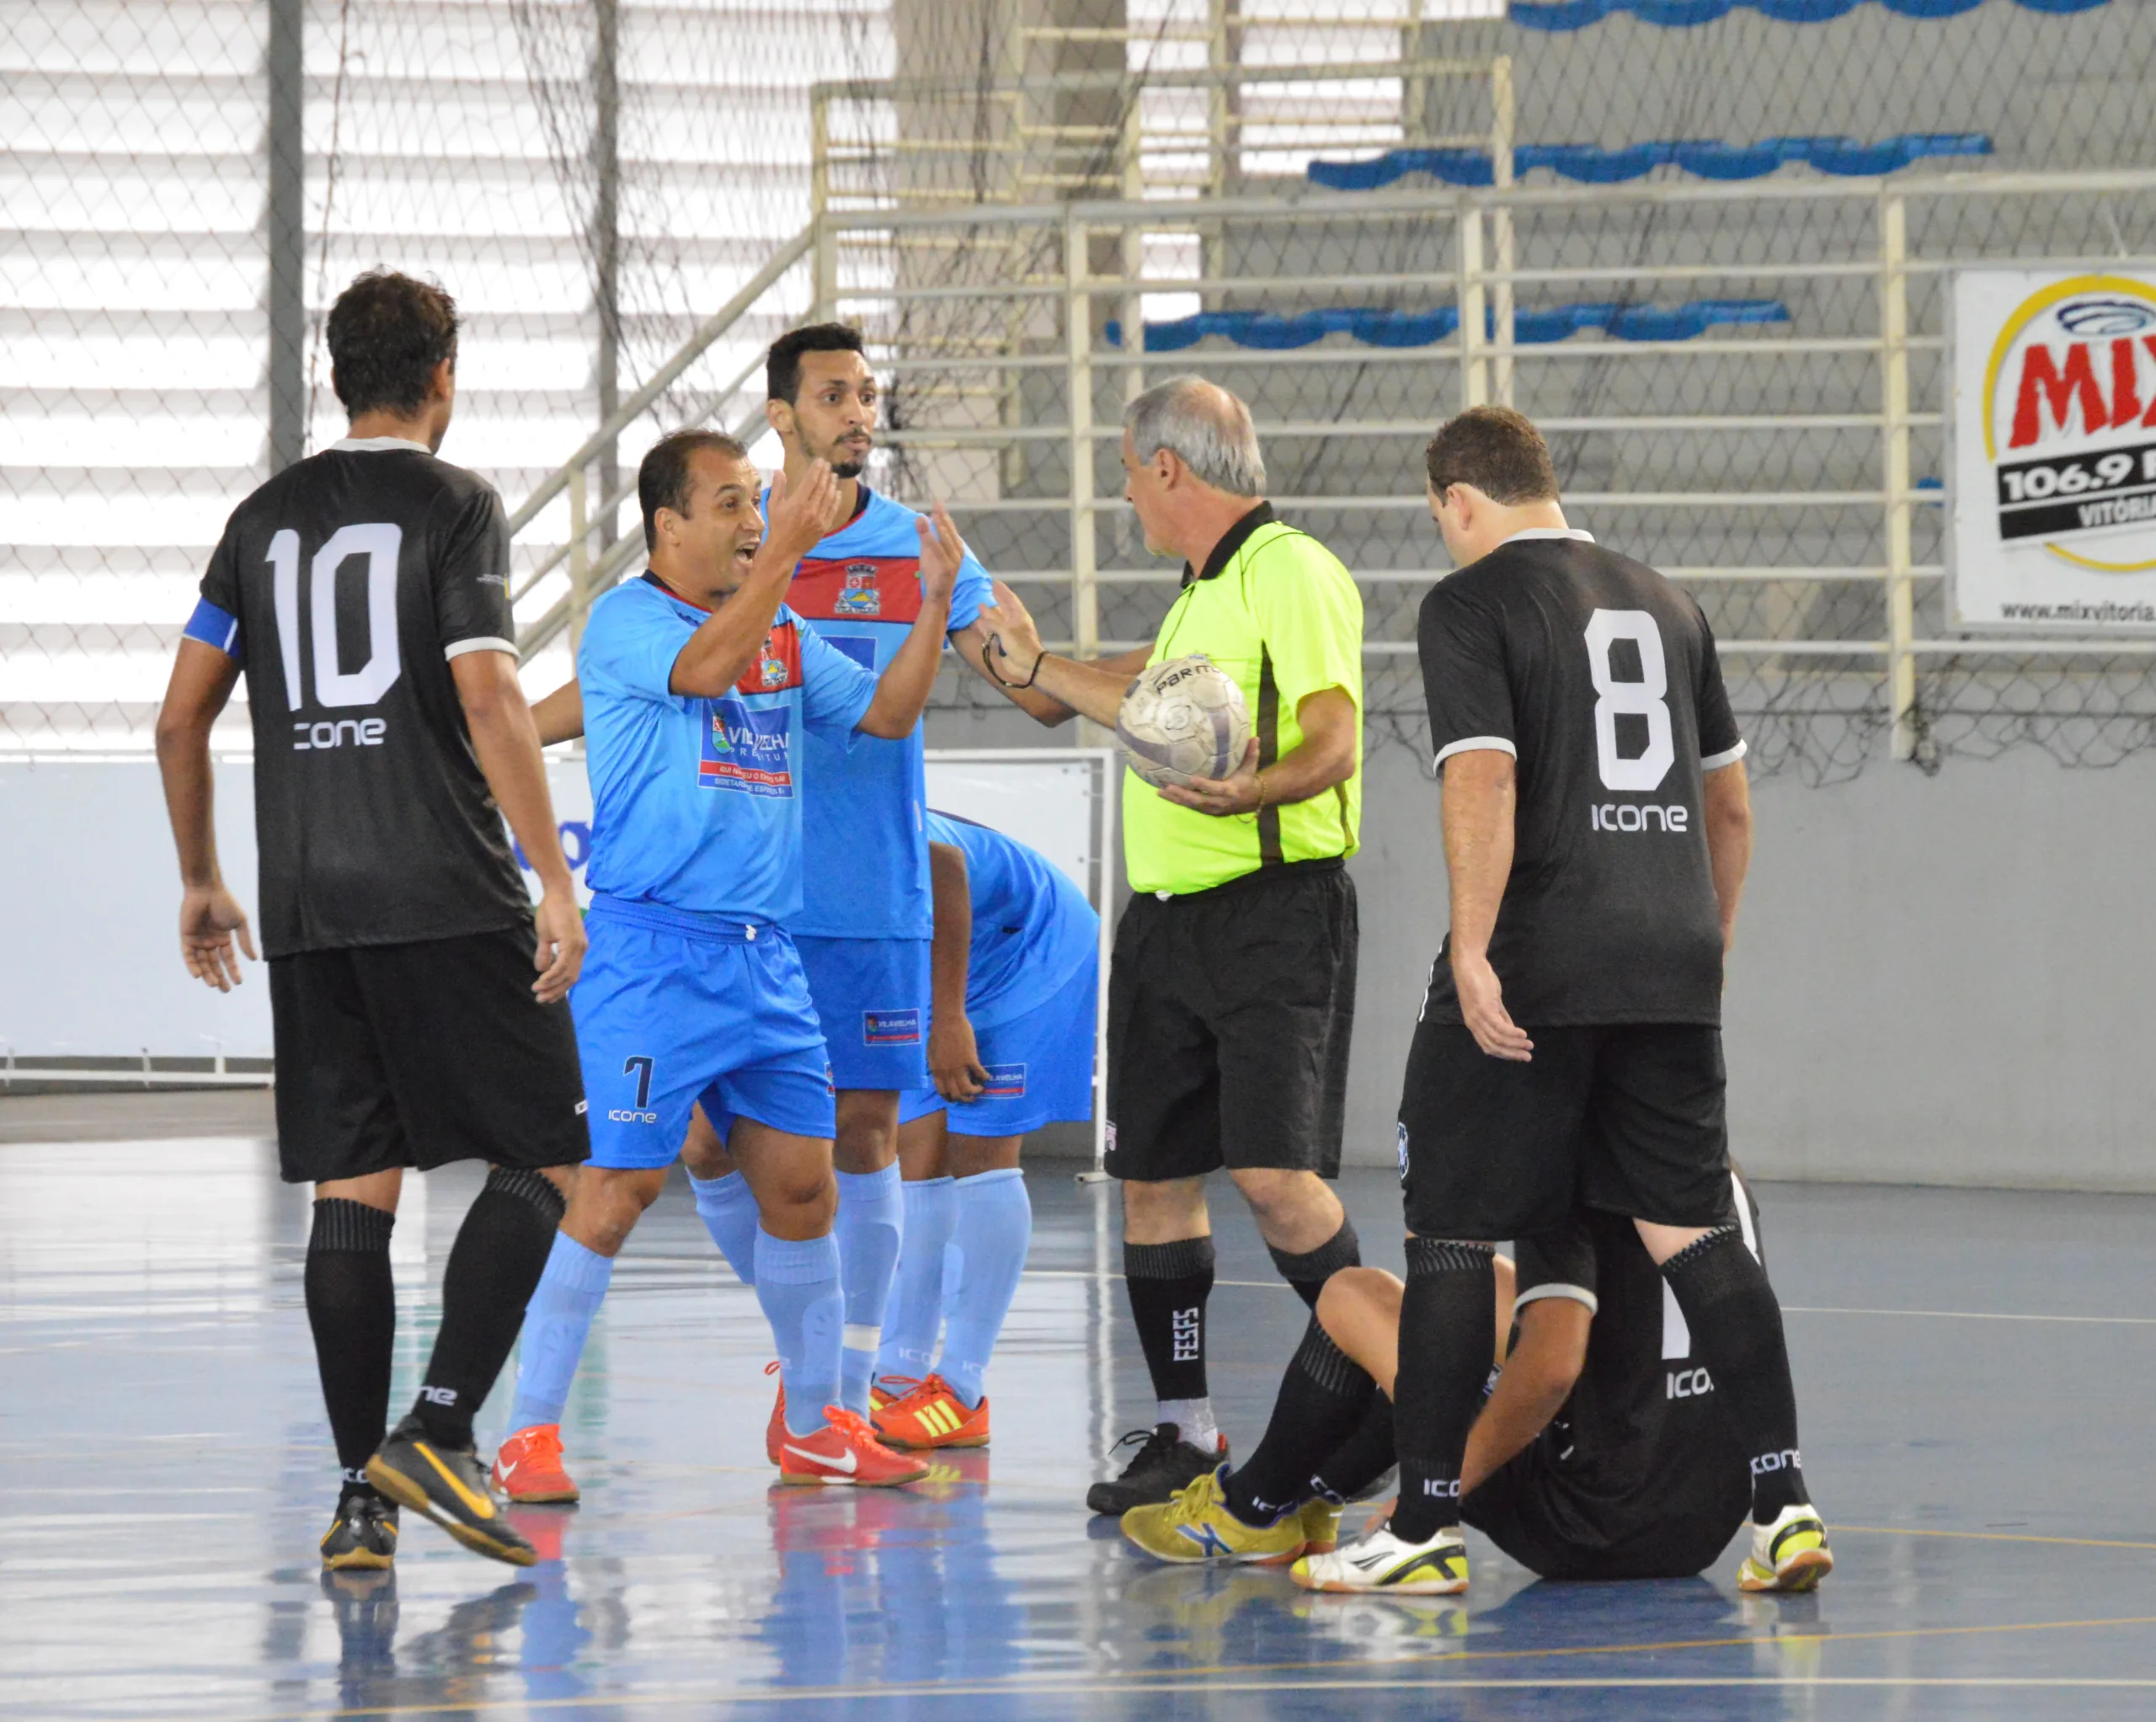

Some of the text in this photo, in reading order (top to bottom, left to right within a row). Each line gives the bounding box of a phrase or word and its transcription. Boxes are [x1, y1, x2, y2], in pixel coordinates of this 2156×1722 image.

[2004, 453, 2134, 503] 106.9
[264, 523, 403, 712] 10
[1583, 607, 1675, 792] 8
[622, 1054, 655, 1110] 7
